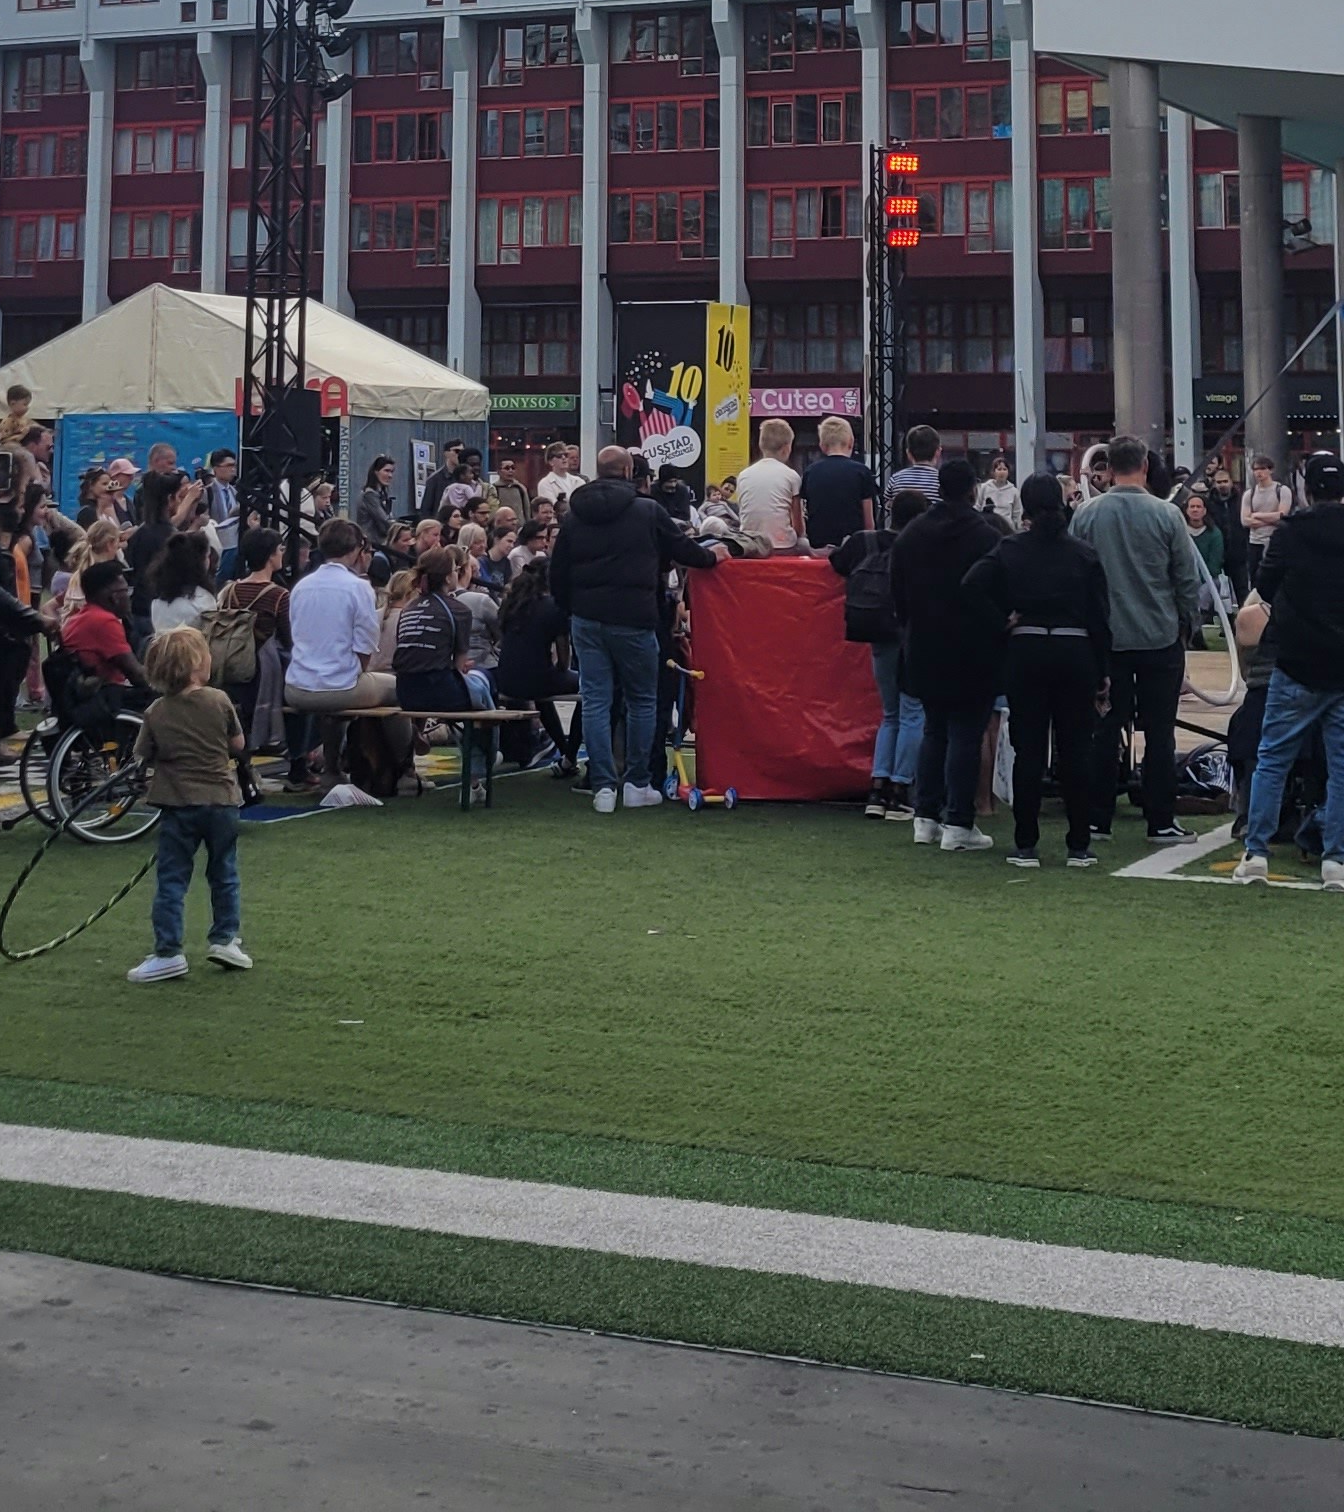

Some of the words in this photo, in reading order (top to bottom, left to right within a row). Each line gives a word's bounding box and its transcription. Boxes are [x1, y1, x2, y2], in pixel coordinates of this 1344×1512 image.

[716, 325, 735, 373] 10
[666, 361, 703, 403] 10
[761, 389, 835, 410] Cutea
[1205, 393, 1238, 404] vintage
[1299, 393, 1322, 402] store
